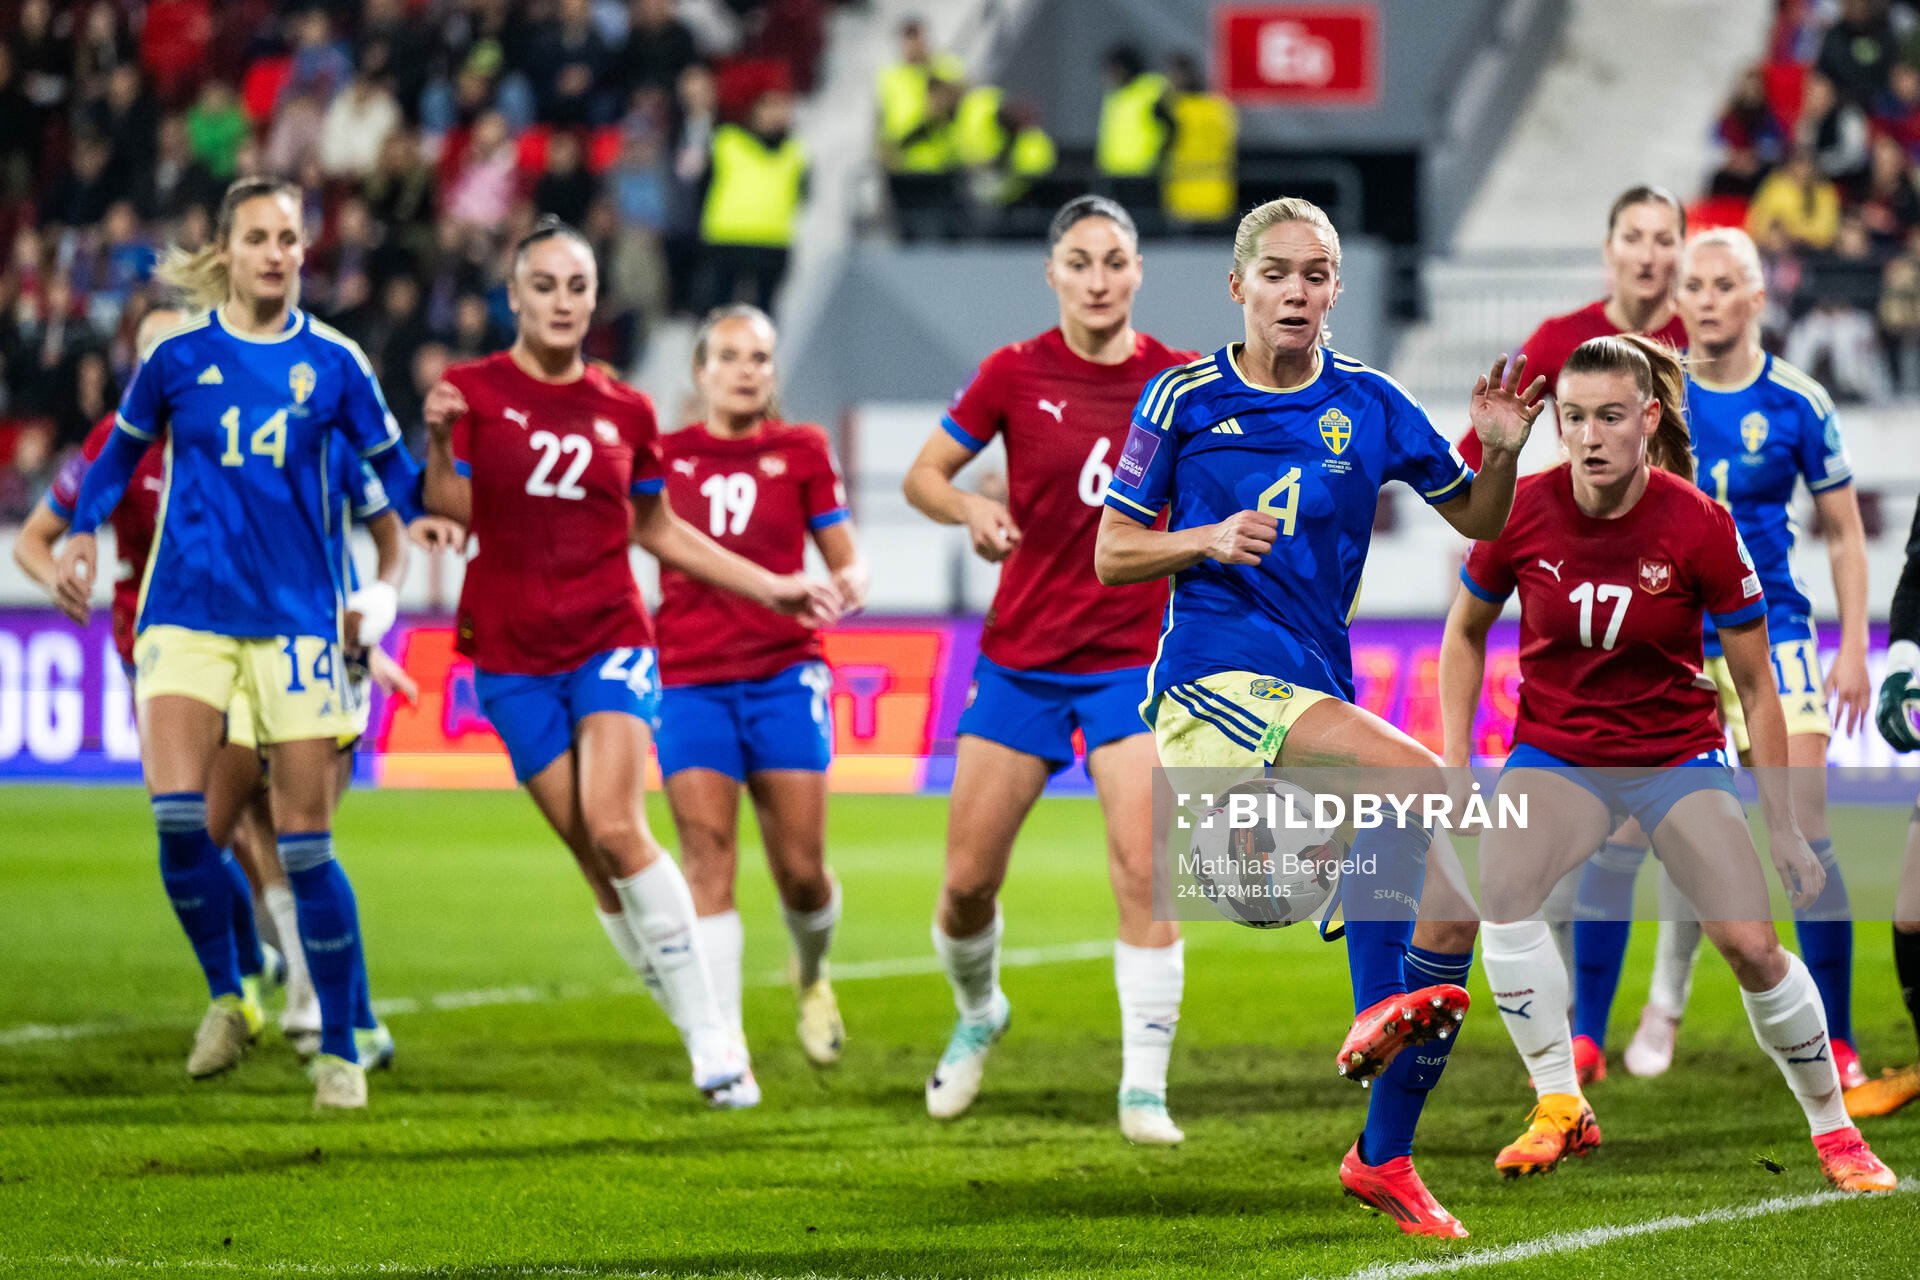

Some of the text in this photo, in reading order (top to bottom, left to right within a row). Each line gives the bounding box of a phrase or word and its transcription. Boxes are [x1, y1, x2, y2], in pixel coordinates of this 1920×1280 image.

[220, 405, 288, 469] 14
[525, 430, 593, 501] 22
[699, 471, 758, 537] 19
[1078, 436, 1114, 508] 6
[1257, 466, 1302, 536] 4
[1568, 581, 1633, 651] 17
[283, 636, 334, 692] 14
[1770, 646, 1815, 694] 11
